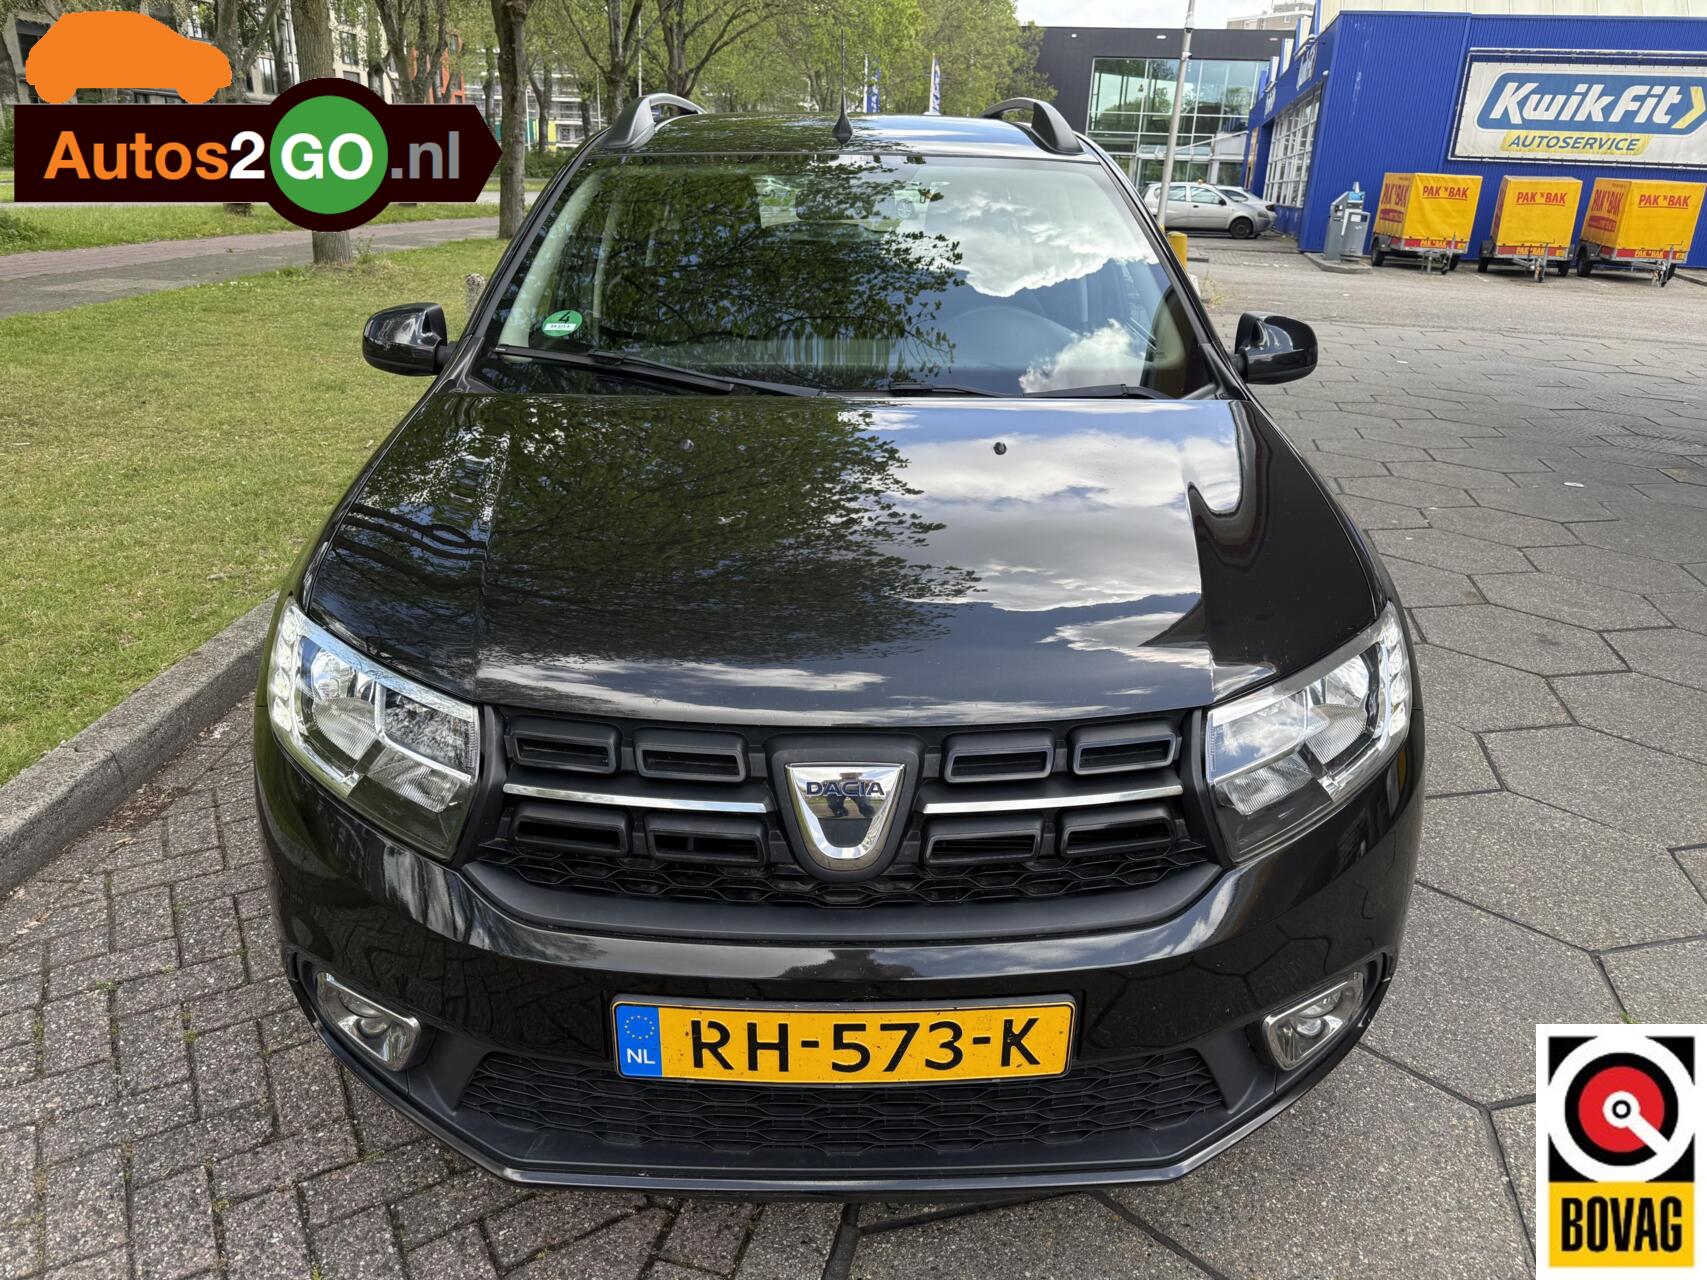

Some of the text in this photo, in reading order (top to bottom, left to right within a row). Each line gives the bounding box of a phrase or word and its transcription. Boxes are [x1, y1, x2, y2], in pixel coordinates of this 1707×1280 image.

[1508, 135, 1641, 151] AUTOSERVICE
[1422, 185, 1442, 197] PAK
[1448, 186, 1470, 199] BAK
[1516, 191, 1538, 203] PAK
[1544, 192, 1568, 204] BAK
[1638, 194, 1661, 206] PAK
[1667, 195, 1692, 207] BAK
[558, 311, 570, 323] 4
[806, 781, 885, 797] DACIA
[690, 1018, 1041, 1073] RH-573-K
[626, 1048, 656, 1065] NL
